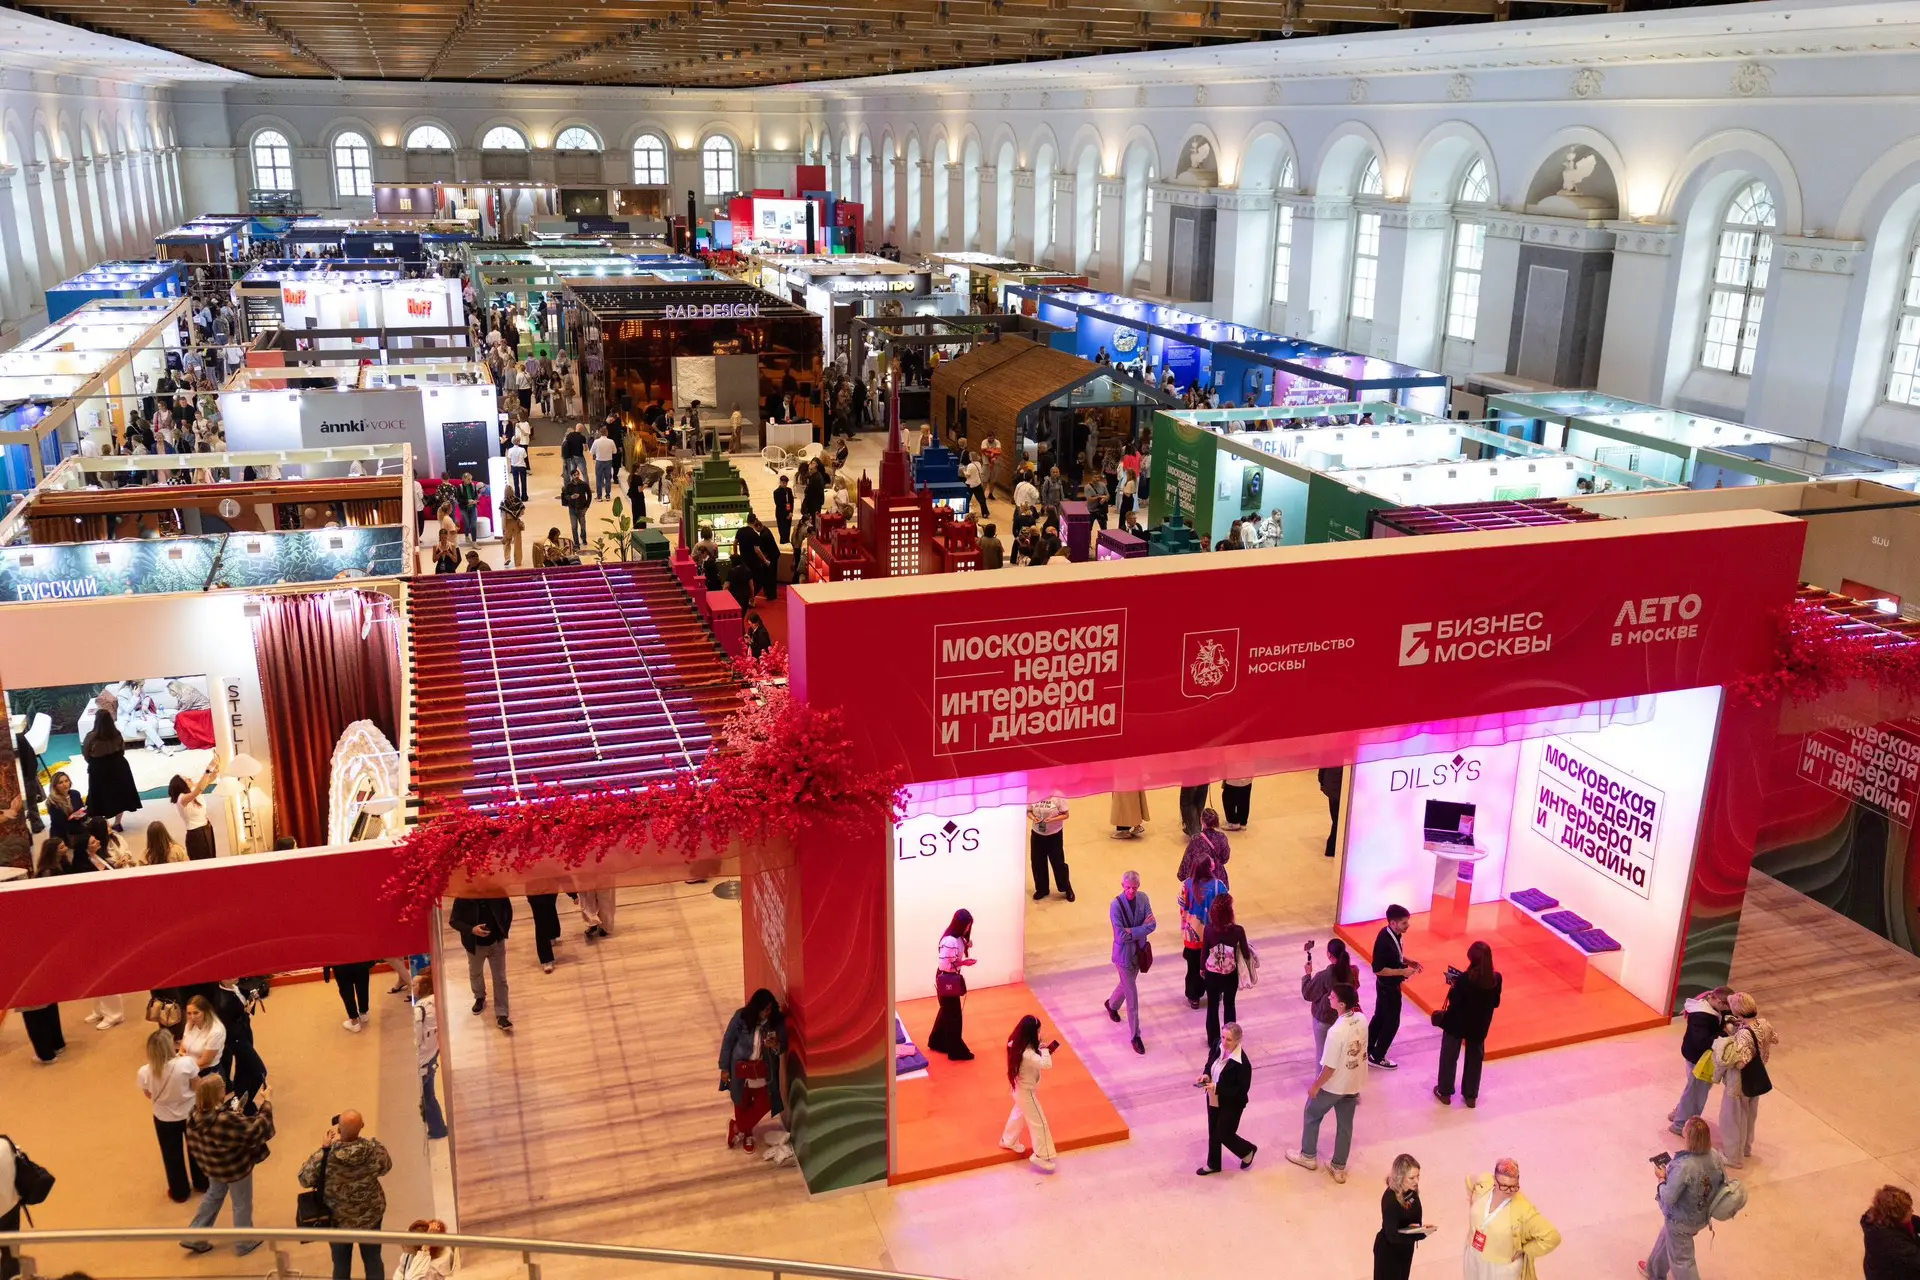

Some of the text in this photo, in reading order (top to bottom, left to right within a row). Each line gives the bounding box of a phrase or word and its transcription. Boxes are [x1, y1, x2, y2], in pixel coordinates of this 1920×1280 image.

[283, 288, 306, 304] Hoff
[888, 281, 915, 292] ПРО
[407, 298, 432, 315] Hoff
[665, 303, 759, 318] RAD DESIGN
[371, 419, 406, 430] VOICE
[1871, 535, 1890, 547] SIJU
[16, 575, 97, 600] РУССКИЙ
[1436, 610, 1544, 639] БИЗНЕС
[1613, 593, 1703, 627] ЛЕТО
[942, 623, 1119, 663] московская
[1249, 637, 1356, 658] ПРАВИТЕЛЬСТВО
[1434, 633, 1552, 663] МОСКВЫ
[1610, 624, 1699, 646] В МОСКВЕ
[1014, 649, 1118, 682] неделя
[1248, 658, 1306, 675] МОСКВЫ
[941, 678, 1095, 717] интерьера
[988, 703, 1116, 743] дизайна
[1390, 757, 1481, 791] DILSYS
[1805, 738, 1900, 793] интерьера
[1850, 738, 1919, 781] неделя
[1545, 743, 1656, 821] московская
[1539, 785, 1632, 856] интерьера
[1581, 787, 1653, 843] неделя
[1561, 824, 1646, 888] дизайна
